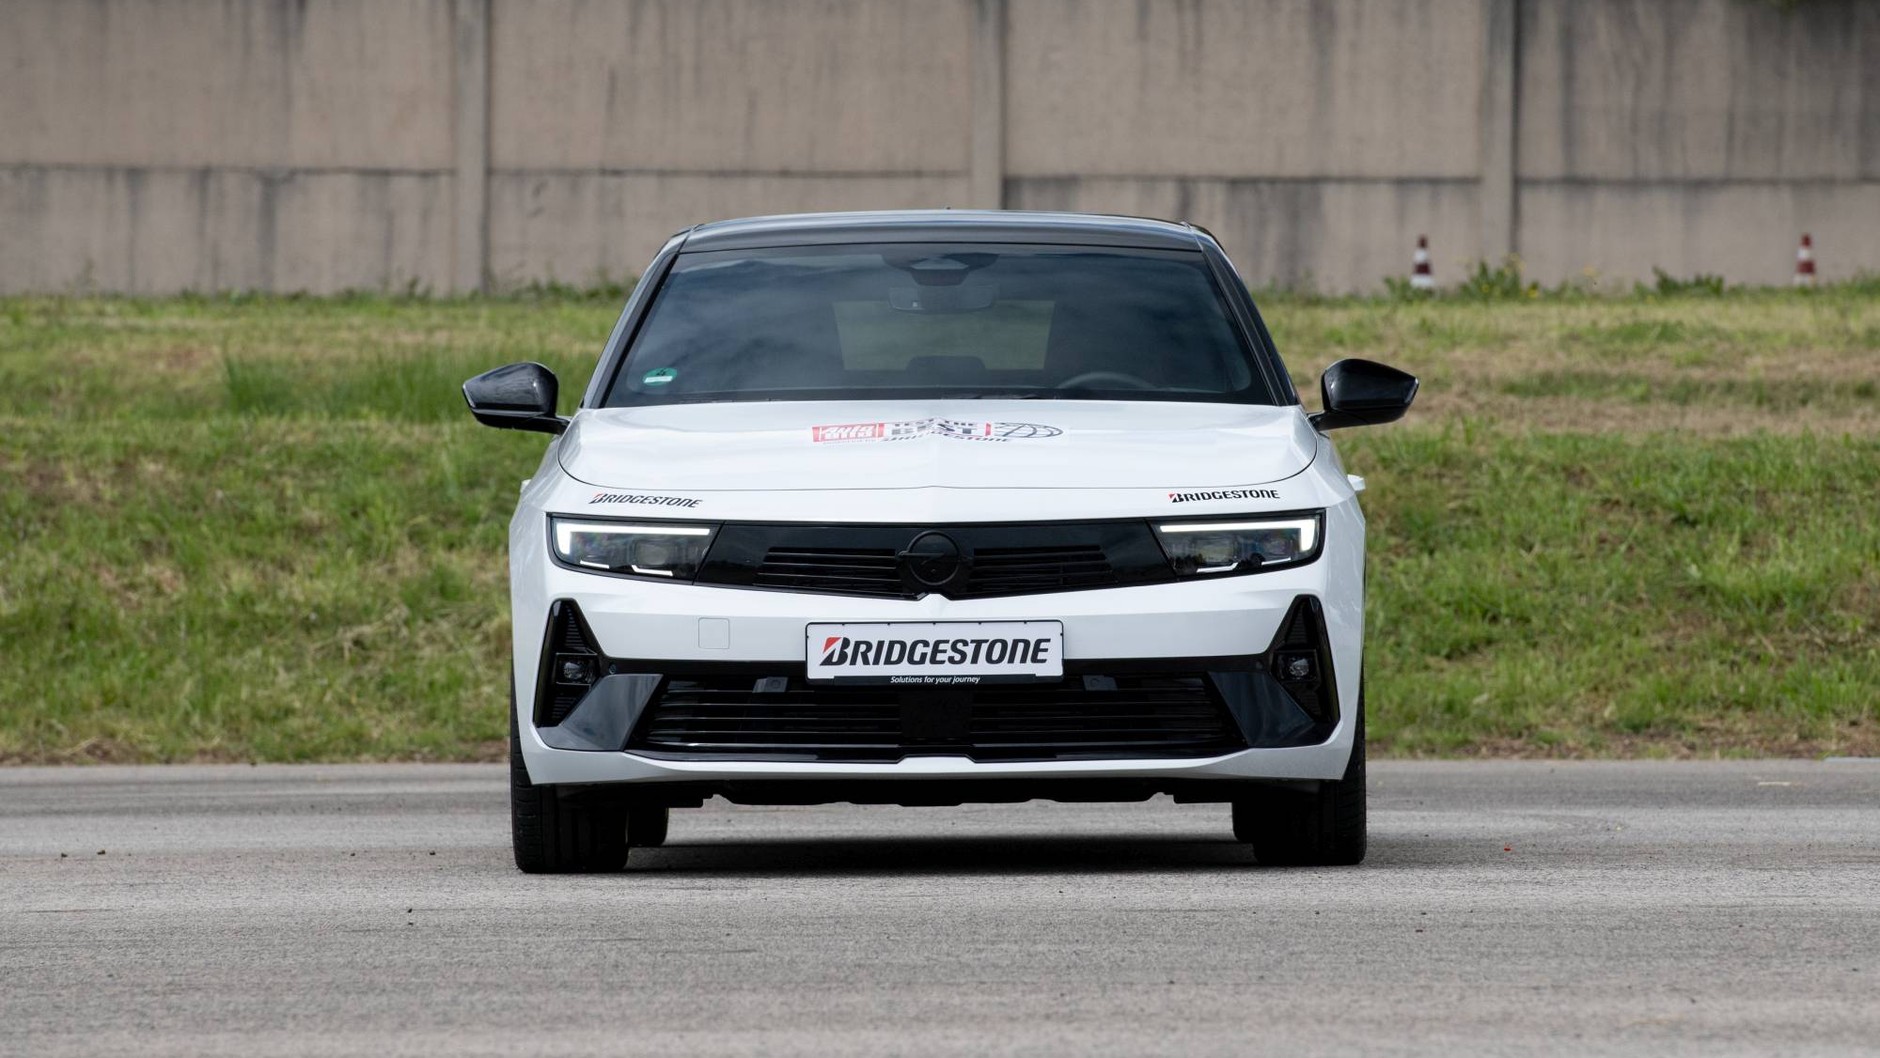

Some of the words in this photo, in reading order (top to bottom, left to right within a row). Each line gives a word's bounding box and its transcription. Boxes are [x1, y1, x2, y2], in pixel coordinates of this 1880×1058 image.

[589, 492, 702, 508] BRIDGESTONE
[1168, 489, 1280, 503] BRIDGESTONE
[819, 637, 1051, 666] BRIDGESTONE
[890, 675, 922, 683] Solutions
[924, 675, 934, 683] for
[952, 675, 980, 684] journey
